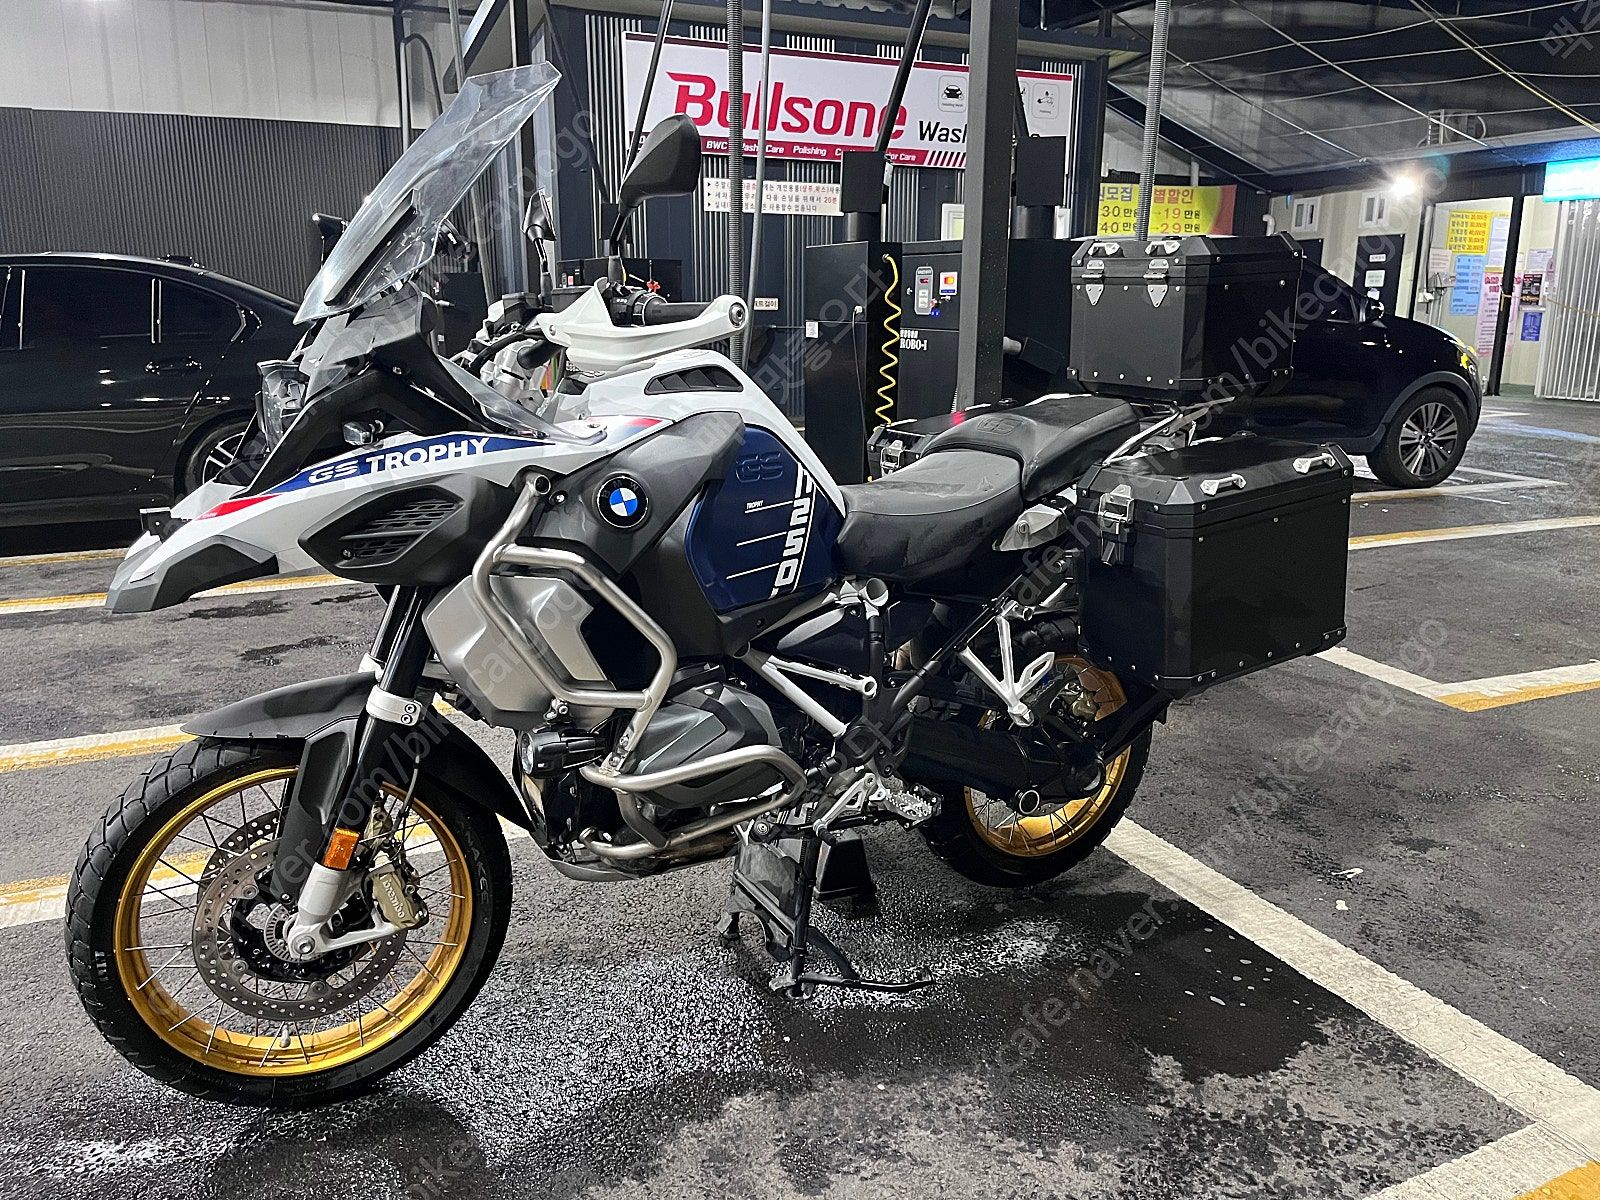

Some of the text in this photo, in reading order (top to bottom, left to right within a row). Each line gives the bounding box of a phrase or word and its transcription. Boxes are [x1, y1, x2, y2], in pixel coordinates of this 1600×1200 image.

[666, 71, 907, 141] Bullsone
[706, 140, 728, 150] BWC
[765, 143, 785, 154] Care
[792, 145, 827, 157] Polishing
[1153, 187, 1194, 204] 별할인
[307, 436, 491, 485] GS TROPHY
[746, 500, 764, 510] TROPHY
[381, 879, 406, 919] brembo
